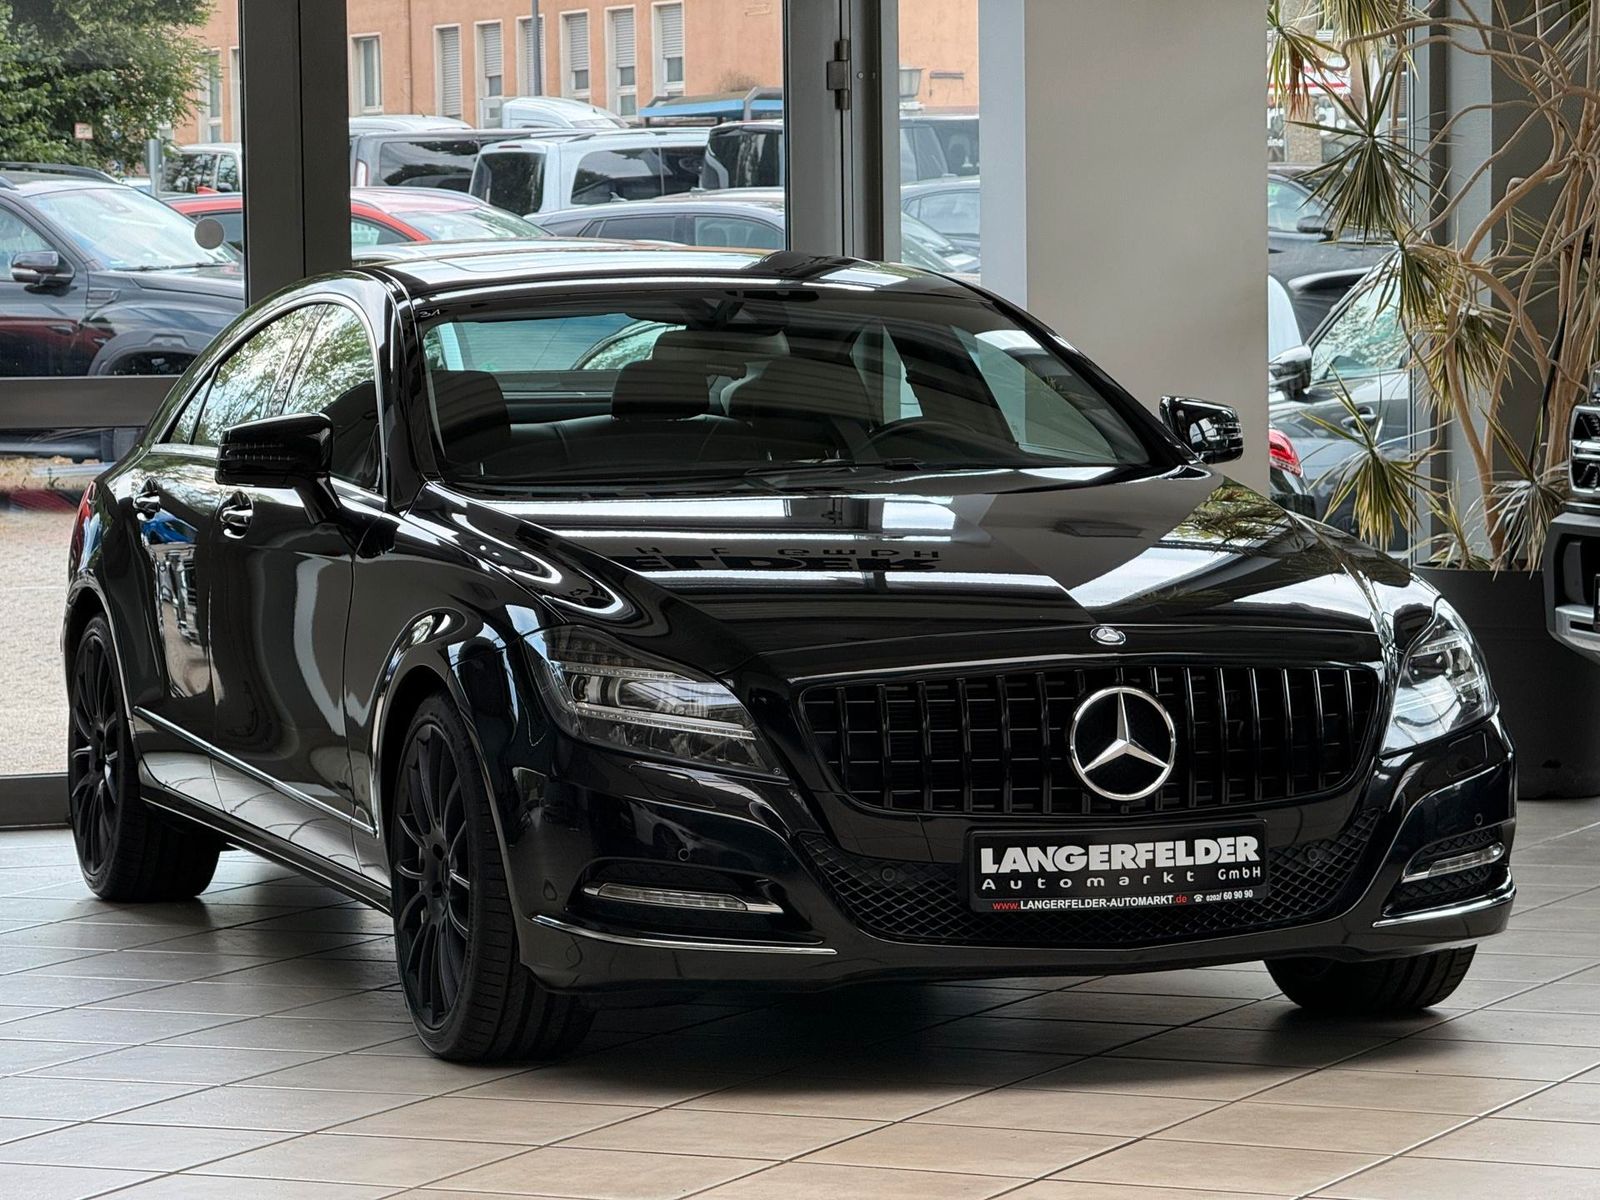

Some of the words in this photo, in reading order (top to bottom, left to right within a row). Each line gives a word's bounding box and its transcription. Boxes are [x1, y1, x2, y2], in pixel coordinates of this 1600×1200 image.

[980, 835, 1260, 874] LANGERFELDER
[981, 870, 1195, 891] Automarkt
[1217, 866, 1262, 881] GmbH
[992, 894, 1188, 911] www.LANGERFELDER-AUTOMARKT.de
[1222, 891, 1233, 900] 60
[1233, 890, 1243, 899] 90
[1243, 889, 1254, 898] 90
